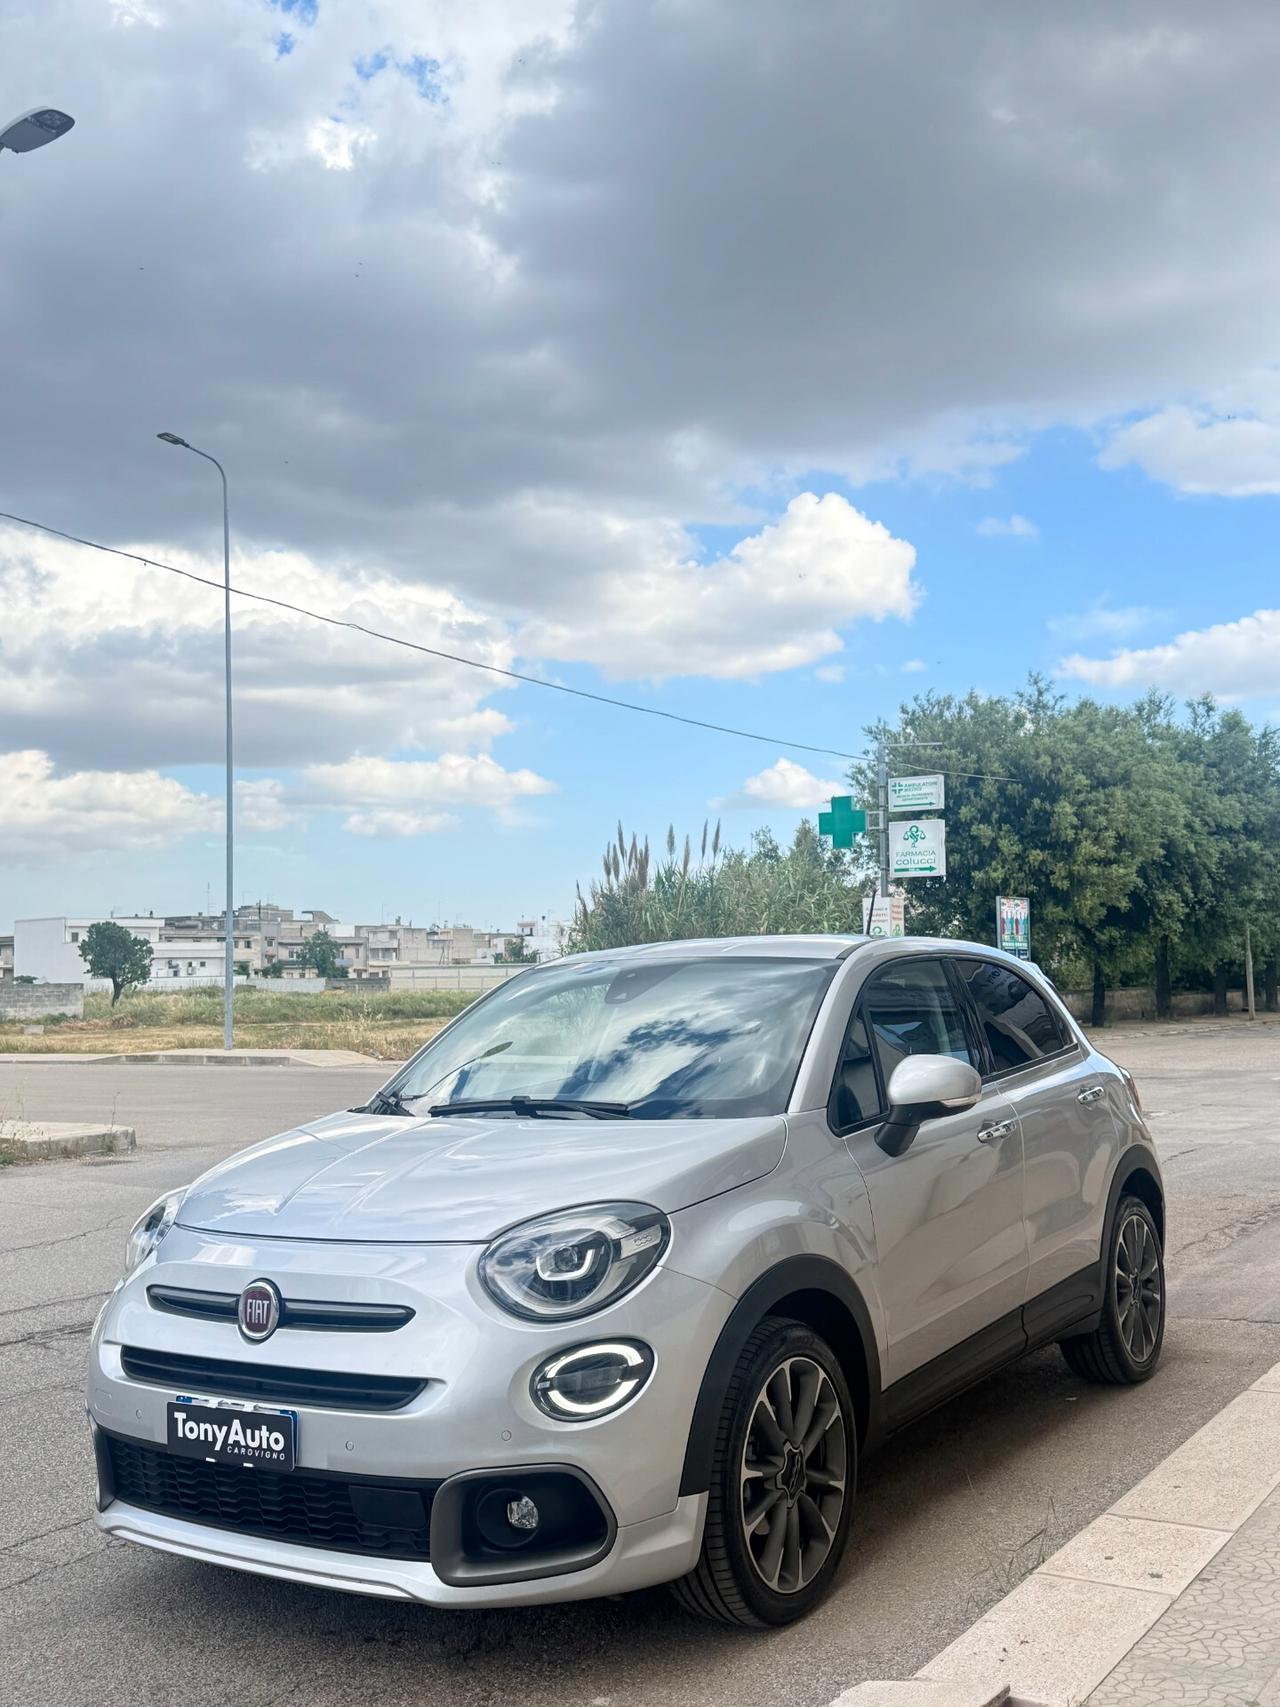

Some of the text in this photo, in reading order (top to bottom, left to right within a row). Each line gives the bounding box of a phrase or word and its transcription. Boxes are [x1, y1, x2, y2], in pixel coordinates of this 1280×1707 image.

[246, 1299, 270, 1324] FIAT
[174, 1411, 285, 1451] TonyAuto
[227, 1445, 286, 1461] CAROVIGNO
